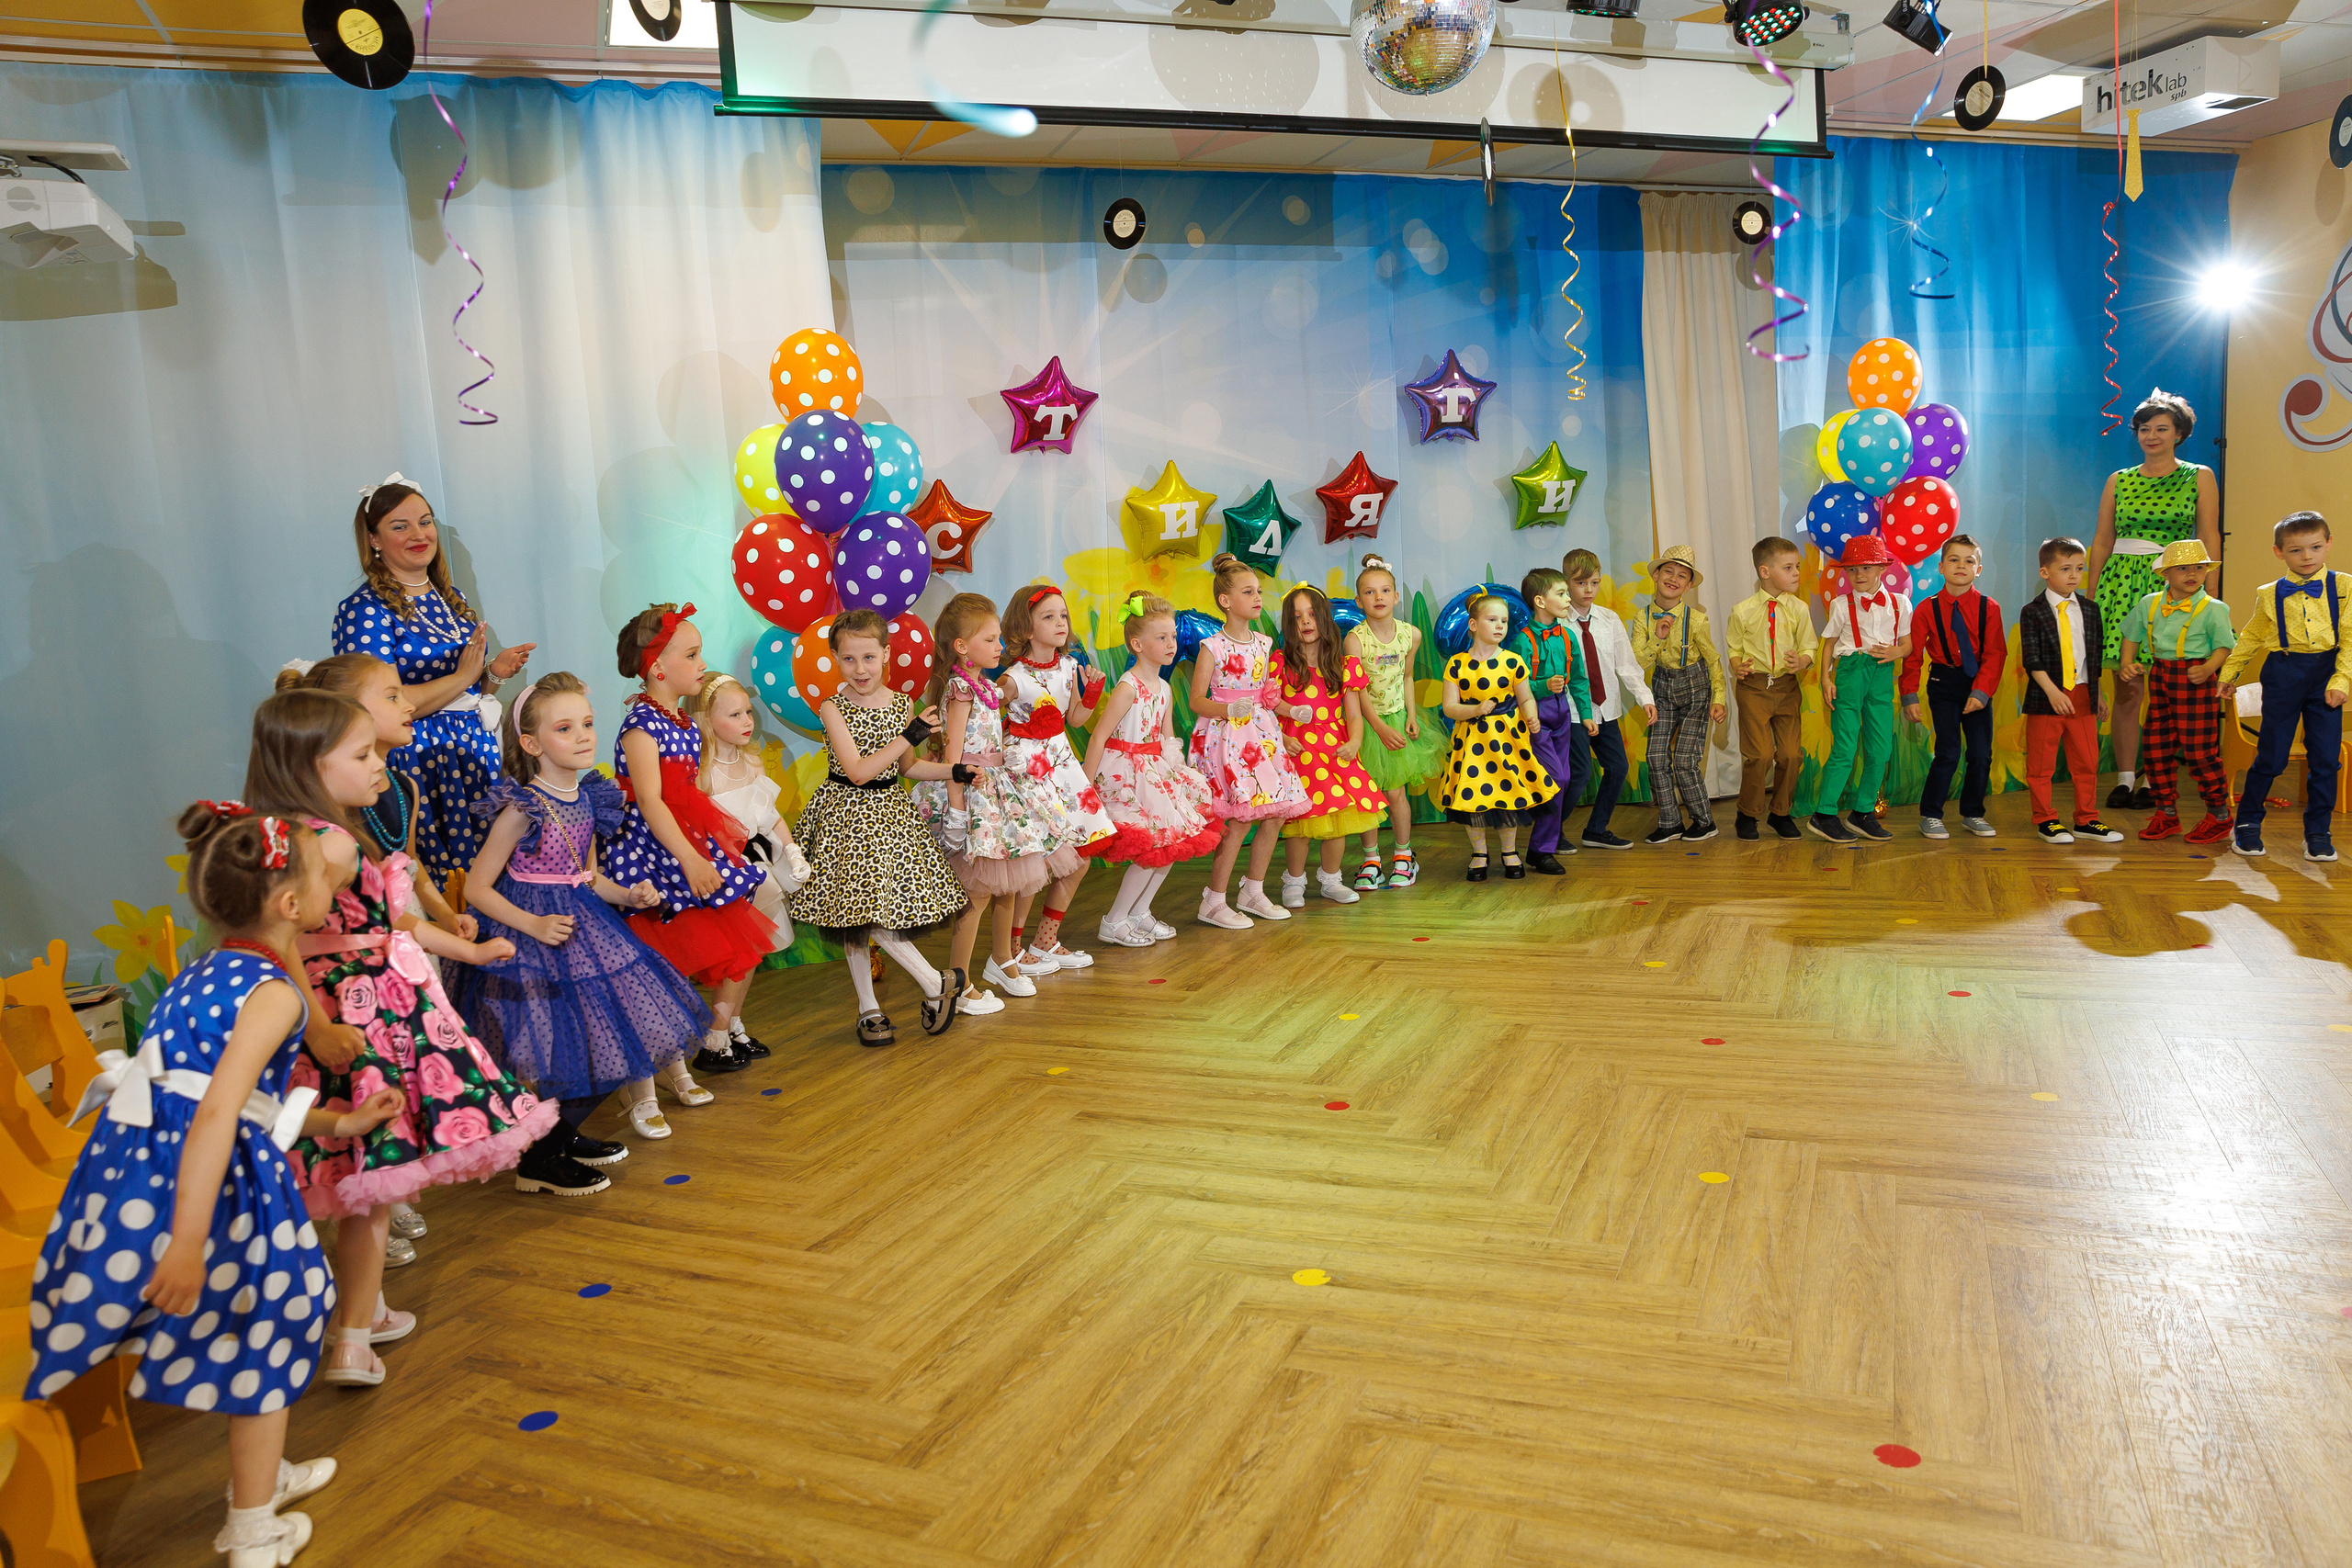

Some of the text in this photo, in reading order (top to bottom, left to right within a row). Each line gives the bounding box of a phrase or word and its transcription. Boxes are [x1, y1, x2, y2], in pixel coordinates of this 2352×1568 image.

[2165, 73, 2187, 93] lab
[2170, 89, 2187, 101] spb
[1034, 403, 1079, 441] Т
[1159, 501, 1200, 540] И
[1344, 492, 1384, 527] Я
[1441, 388, 1476, 423] Г
[1537, 479, 1577, 513] И
